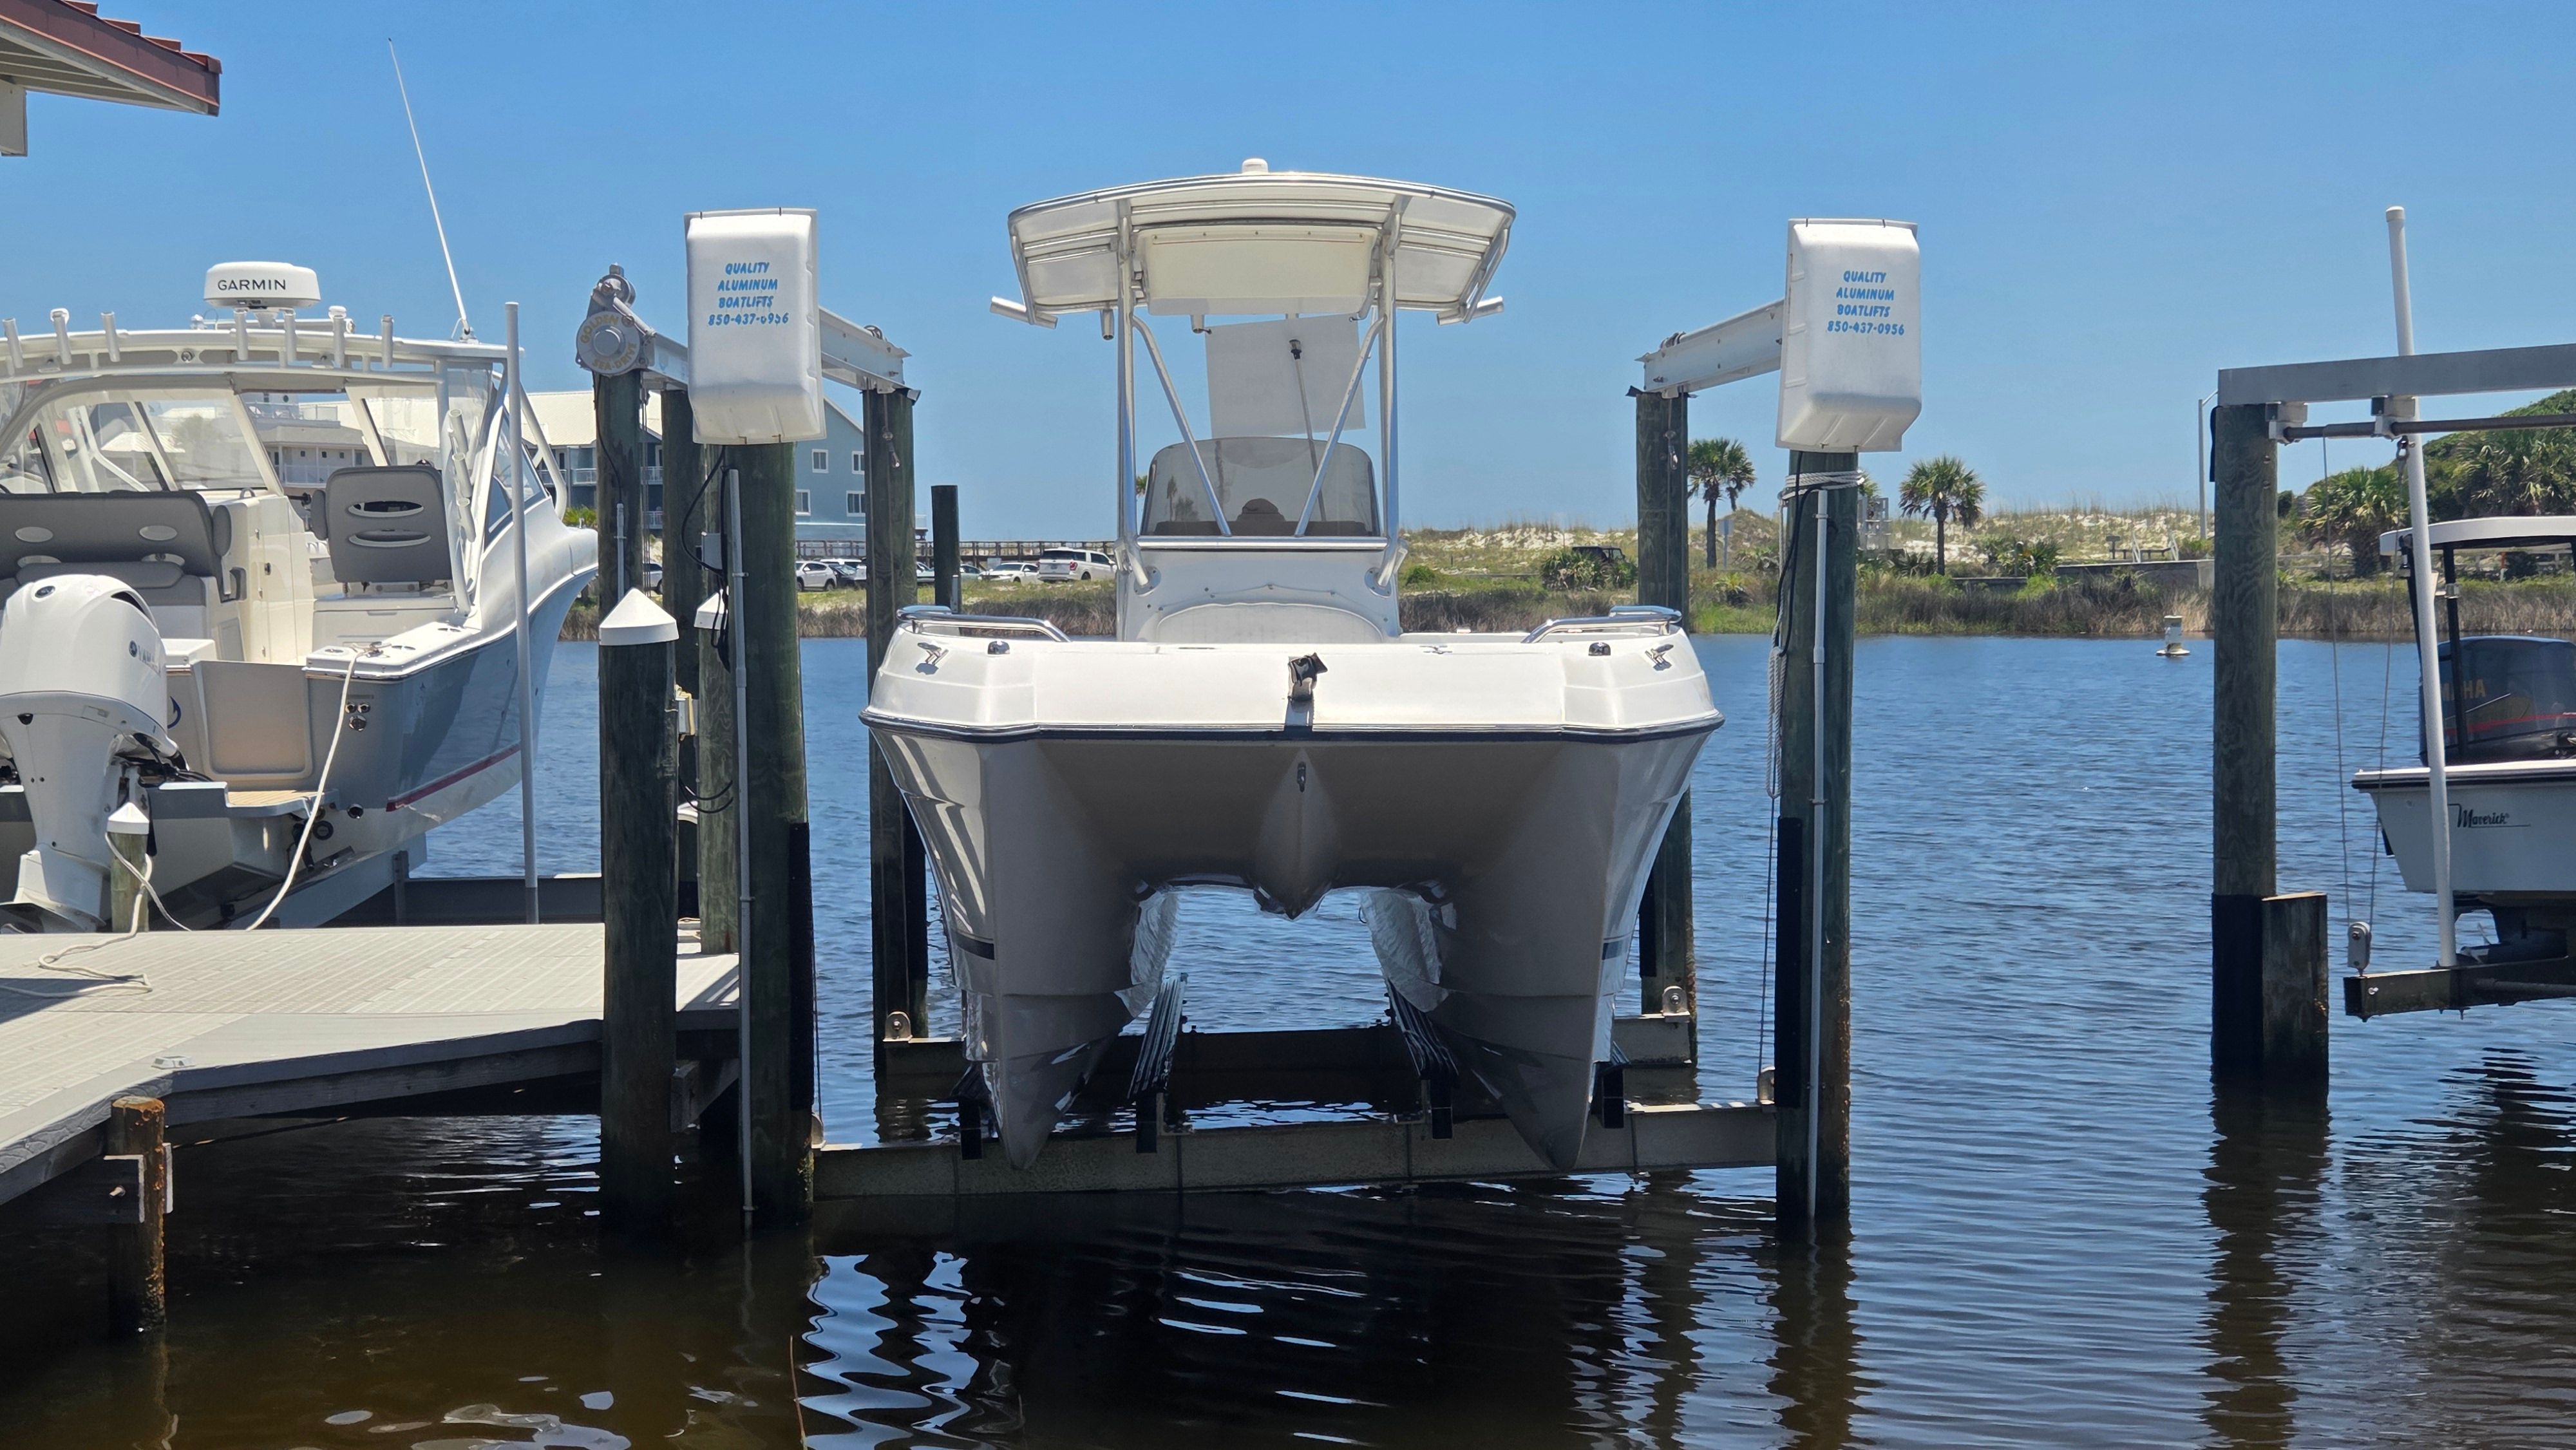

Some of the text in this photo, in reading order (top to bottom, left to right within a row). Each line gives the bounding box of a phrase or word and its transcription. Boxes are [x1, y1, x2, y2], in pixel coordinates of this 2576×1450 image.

[725, 262, 770, 275] QUALITY
[1843, 270, 1887, 283] QUALITY
[217, 279, 287, 290] GARMIN
[717, 279, 778, 291] ALUMINUM
[1836, 287, 1895, 301] ALUMINUM
[718, 296, 774, 308] BOATLIFTS
[1837, 304, 1891, 317] BOATLIFTS
[580, 314, 619, 343] GOLDEN
[1827, 321, 1905, 335] 850-437-0956
